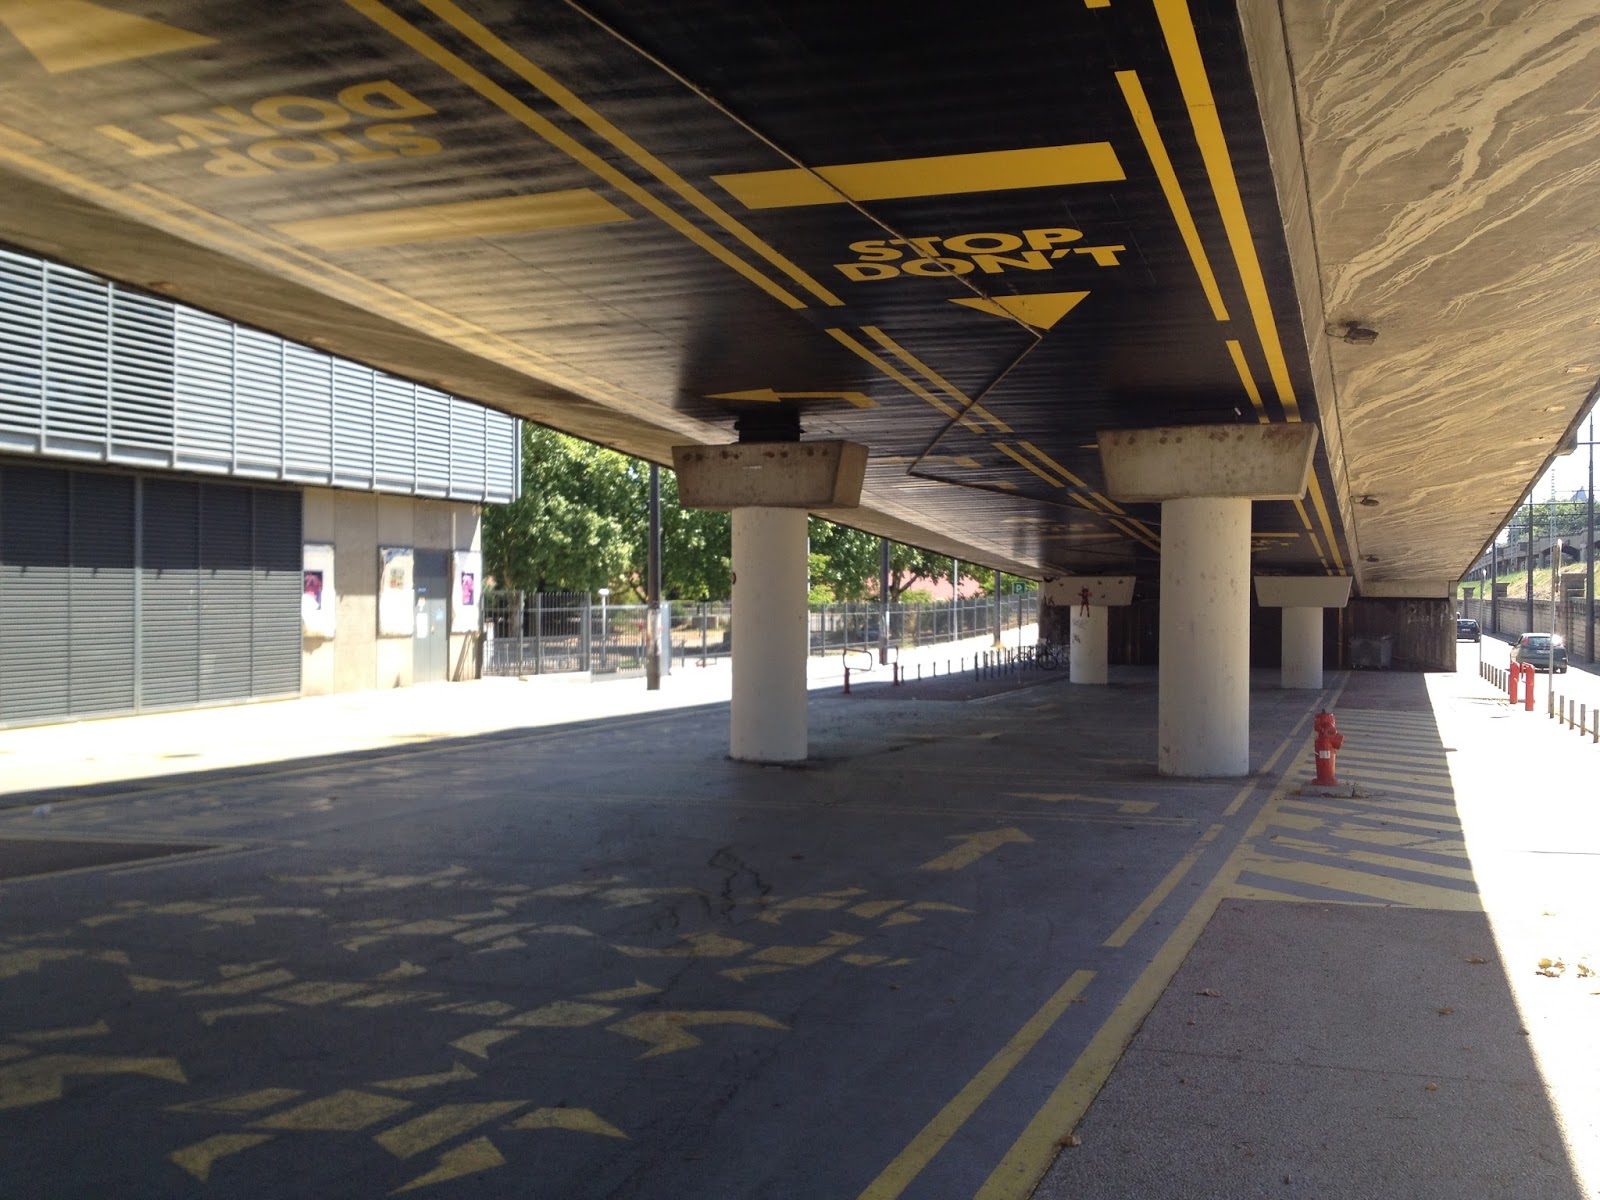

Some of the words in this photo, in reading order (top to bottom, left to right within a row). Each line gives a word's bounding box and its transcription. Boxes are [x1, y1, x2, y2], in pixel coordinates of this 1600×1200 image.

[204, 123, 443, 178] STOP
[849, 228, 1083, 261] STOP
[833, 245, 1126, 281] DON'T
